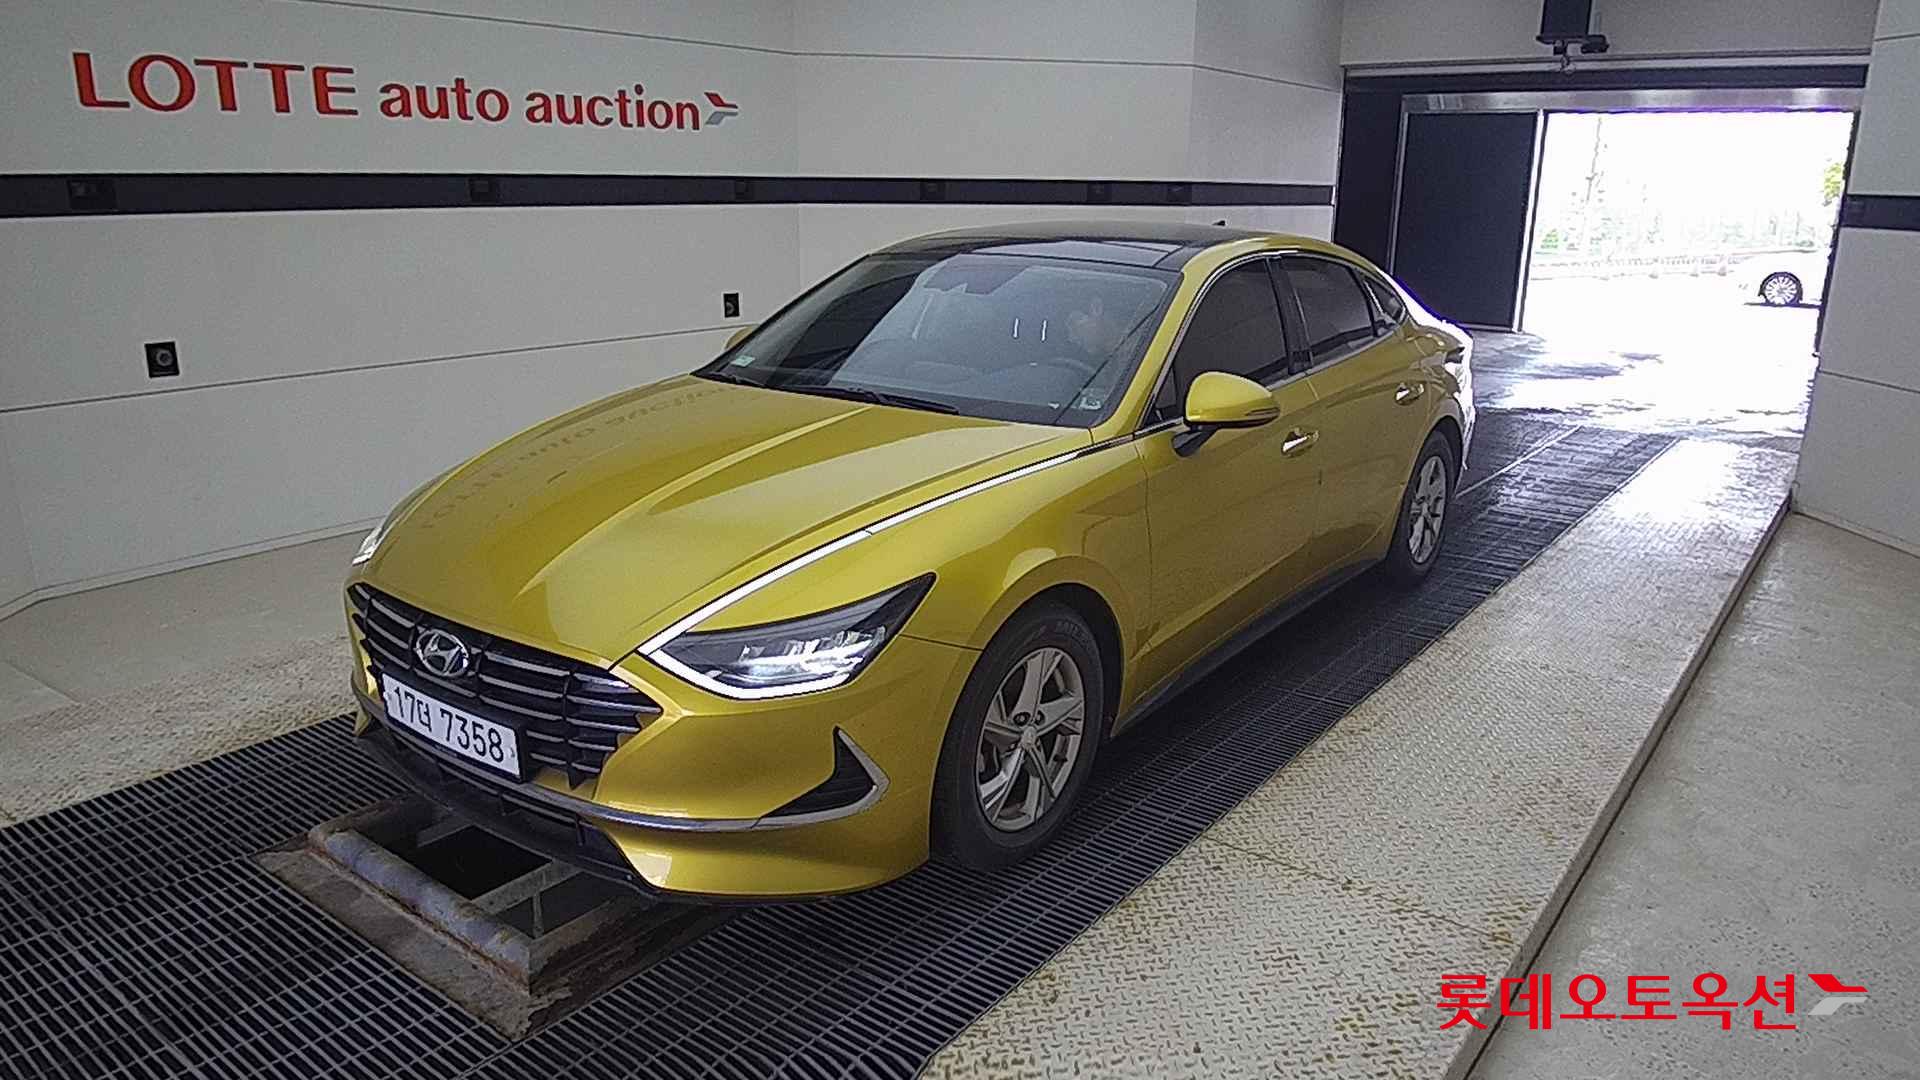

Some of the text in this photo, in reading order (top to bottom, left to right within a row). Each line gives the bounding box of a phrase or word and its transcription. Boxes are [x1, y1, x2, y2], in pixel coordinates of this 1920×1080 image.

[72, 52, 700, 131] LOTTE auto auction
[394, 686, 504, 763] 17더 7358
